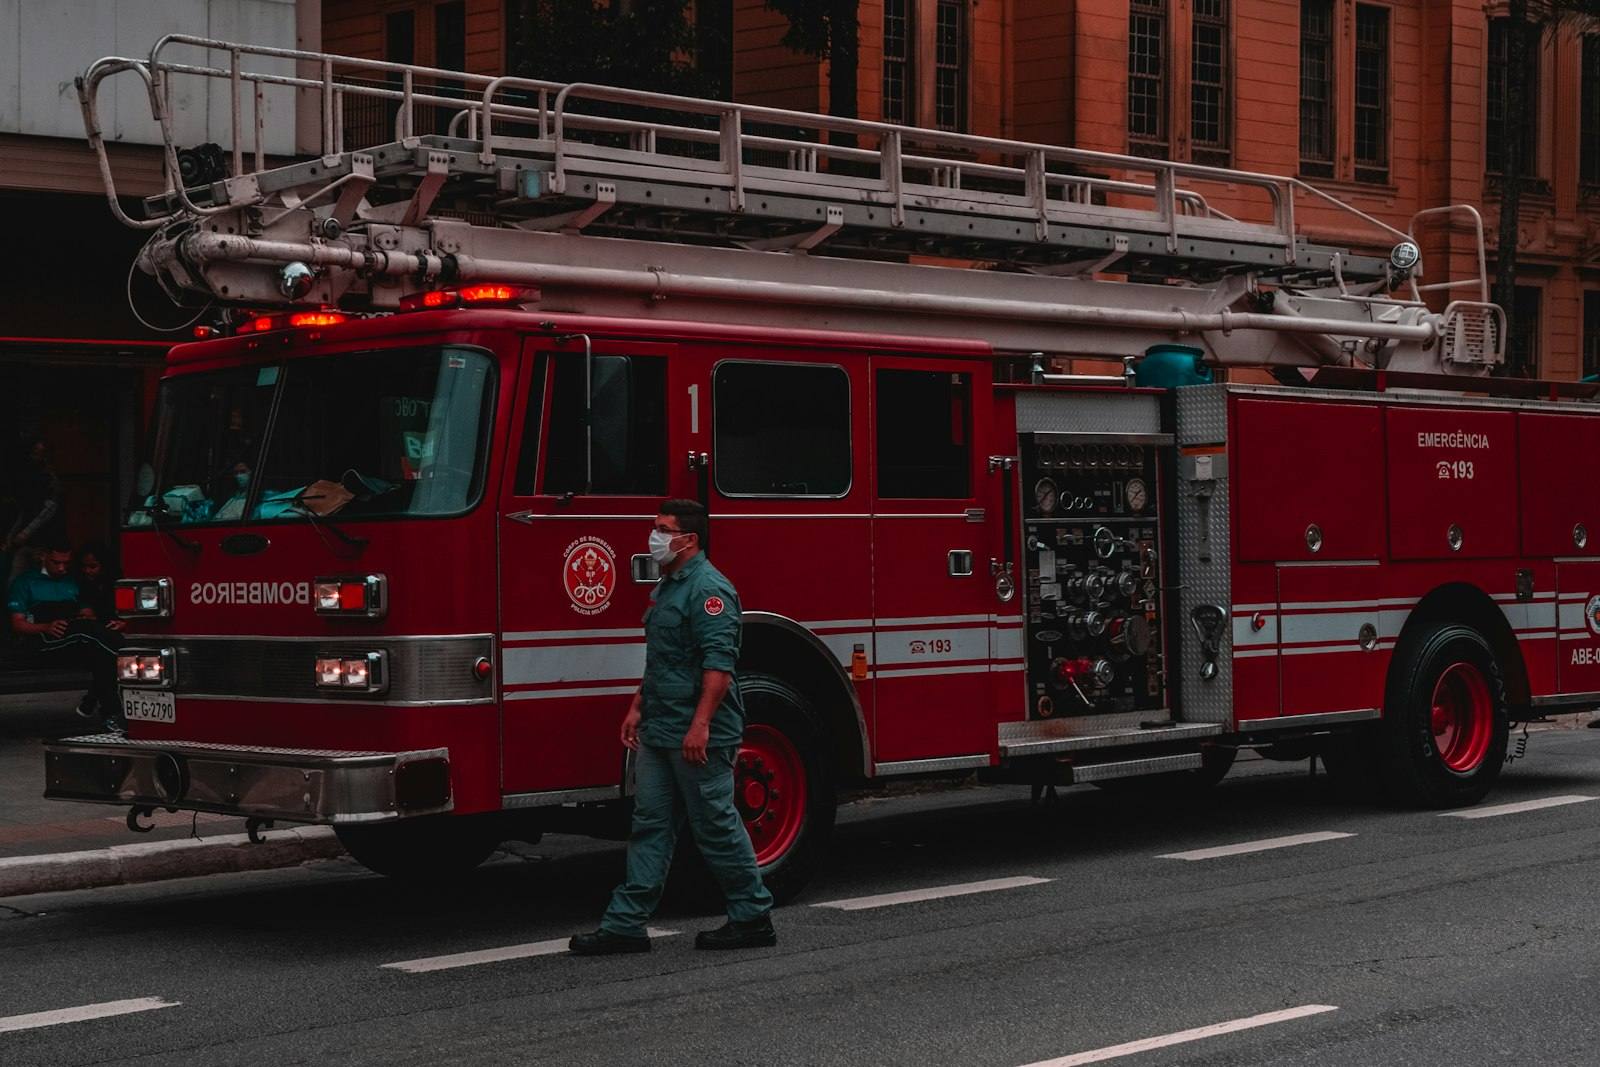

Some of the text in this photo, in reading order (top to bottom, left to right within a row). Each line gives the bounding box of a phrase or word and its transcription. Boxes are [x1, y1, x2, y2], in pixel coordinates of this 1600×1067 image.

[687, 383, 699, 433] 1
[1417, 429, 1490, 449] EMERGÊNCIA
[1452, 460, 1474, 480] 193
[928, 639, 952, 654] 193
